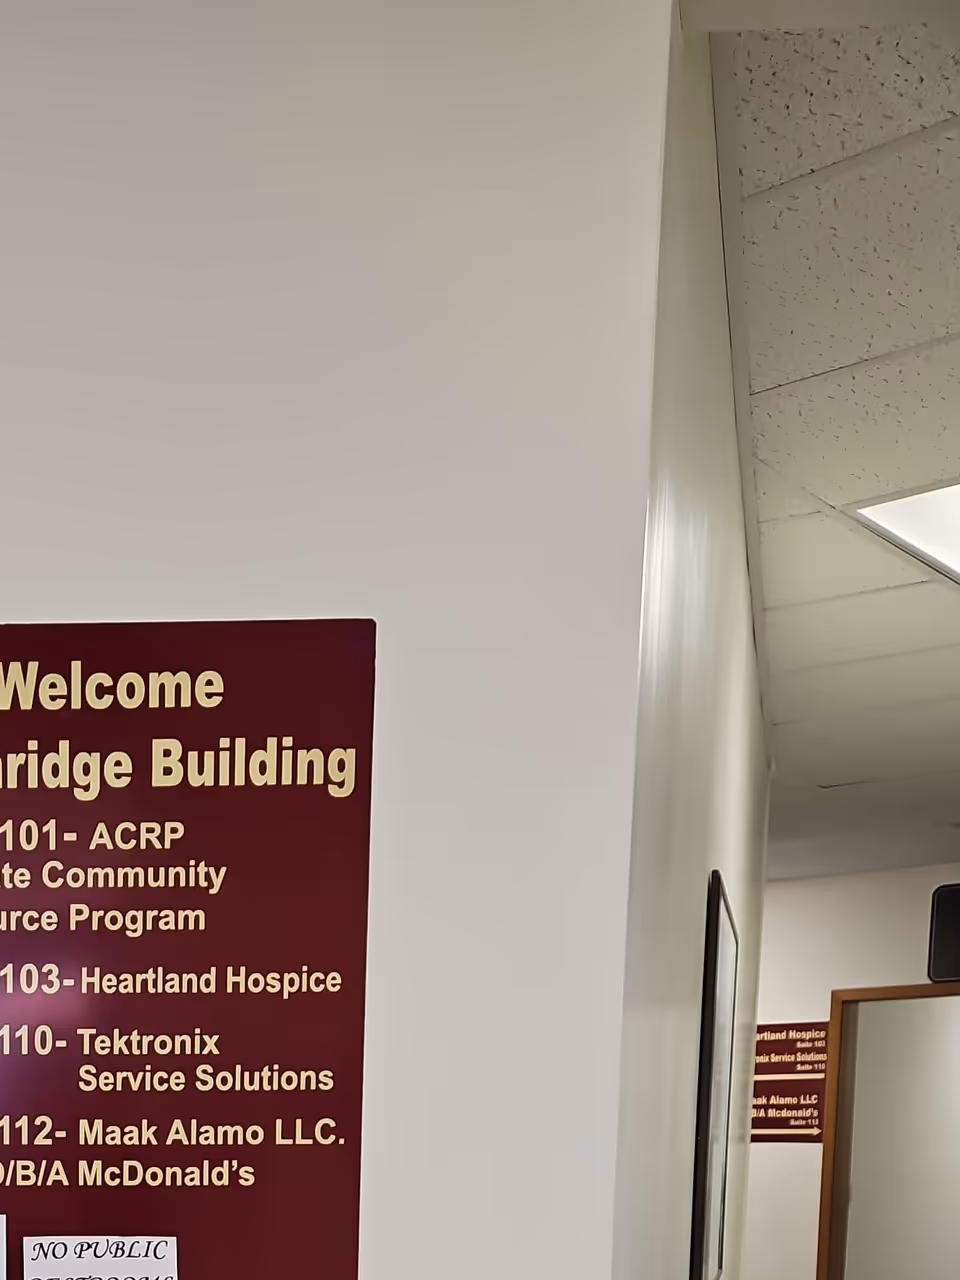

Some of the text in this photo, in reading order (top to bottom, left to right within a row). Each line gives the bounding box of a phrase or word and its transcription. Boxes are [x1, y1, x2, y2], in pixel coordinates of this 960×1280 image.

[152, 737, 356, 797] Building
[0, 818, 77, 851] 101-
[89, 822, 184, 850] ACRP
[42, 860, 227, 894] Community
[69, 904, 206, 937] Program
[0, 963, 74, 994] 103-
[81, 967, 216, 994] Heartland
[227, 966, 342, 999] Hospice
[77, 1028, 219, 1055] Tektronix
[789, 1029, 826, 1040] Hospice
[770, 1052, 795, 1062] Service
[796, 1052, 827, 1061] Solutions
[79, 1064, 334, 1092] Service Solutions
[769, 1095, 798, 1105] Alamo
[800, 1094, 818, 1105] LLC
[79, 1119, 157, 1145] Maak
[166, 1119, 264, 1145] Alamo
[275, 1118, 345, 1145] LLC.
[78, 1159, 256, 1187] McDonald's
[31, 1239, 169, 1261] NO PUBLIC
